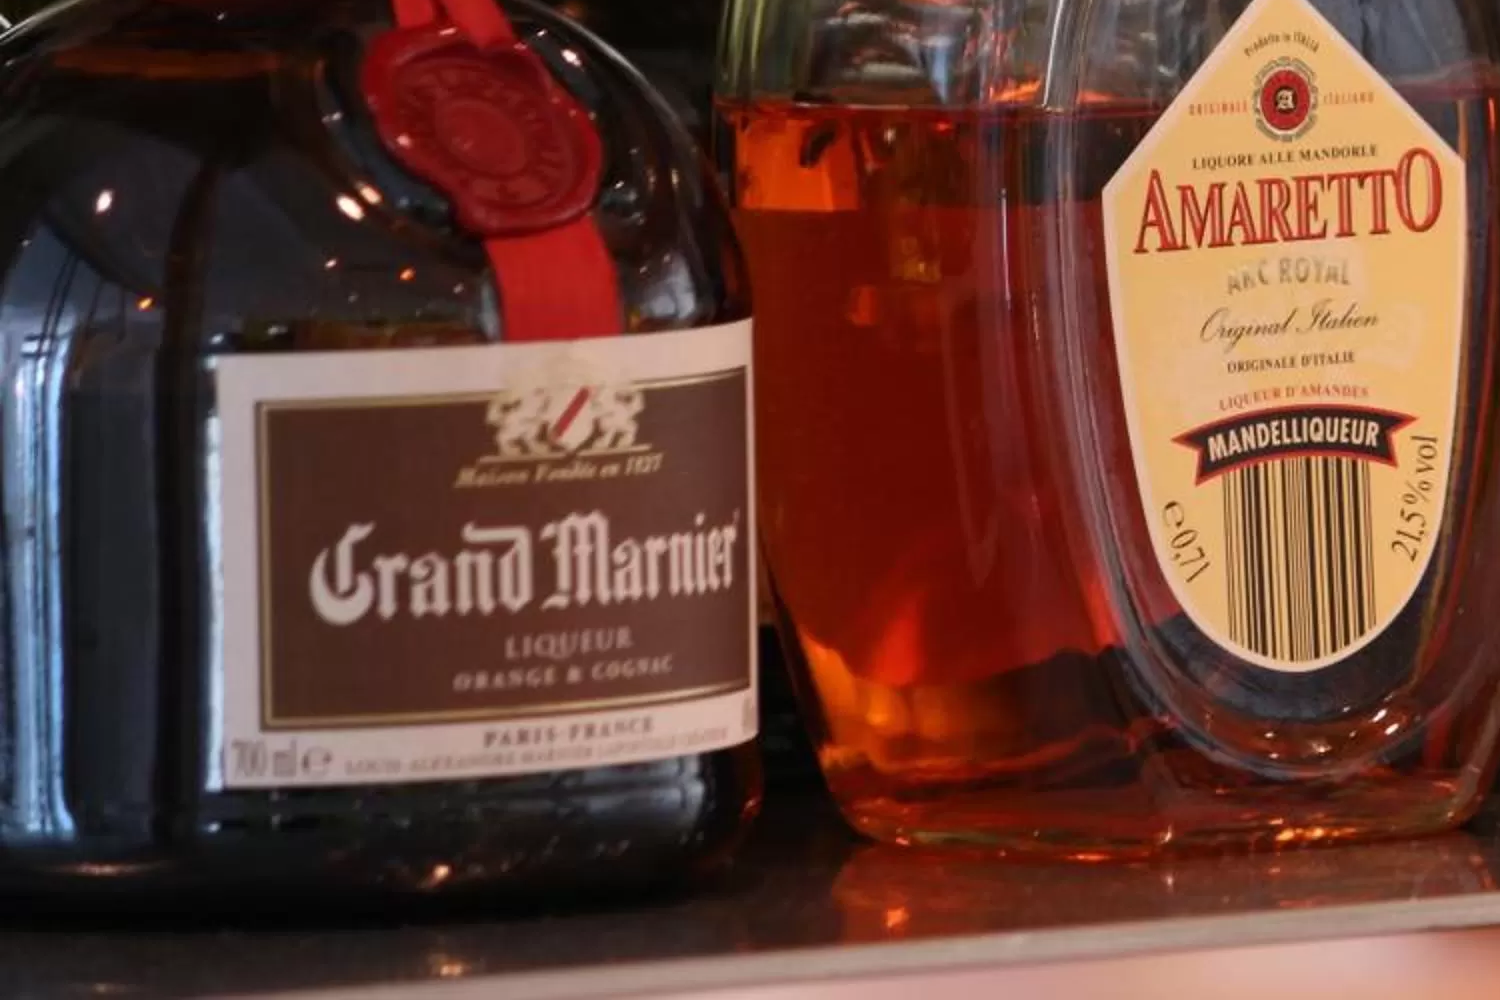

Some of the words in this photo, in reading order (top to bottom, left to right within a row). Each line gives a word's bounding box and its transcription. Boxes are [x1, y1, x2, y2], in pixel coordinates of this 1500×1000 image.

[1191, 151, 1255, 172] LIQUORE
[1259, 149, 1295, 165] ALLE
[1299, 142, 1379, 163] MANDORLE
[1133, 147, 1444, 255] AMARETTO
[1278, 257, 1352, 287] ROYAL
[1199, 306, 1298, 354] Original
[1295, 297, 1379, 335] Italien
[1227, 355, 1297, 375] ORIGINALE
[1300, 349, 1356, 368] D'ITALIE
[1218, 386, 1282, 412] LIQUEUR
[1206, 416, 1381, 463] MANDELLIQUEUR
[309, 519, 532, 627] Grand
[539, 507, 740, 611] Marnier
[504, 624, 634, 661] LIQUEUR
[452, 665, 557, 692] ORANGE
[590, 653, 675, 681] COGNAC
